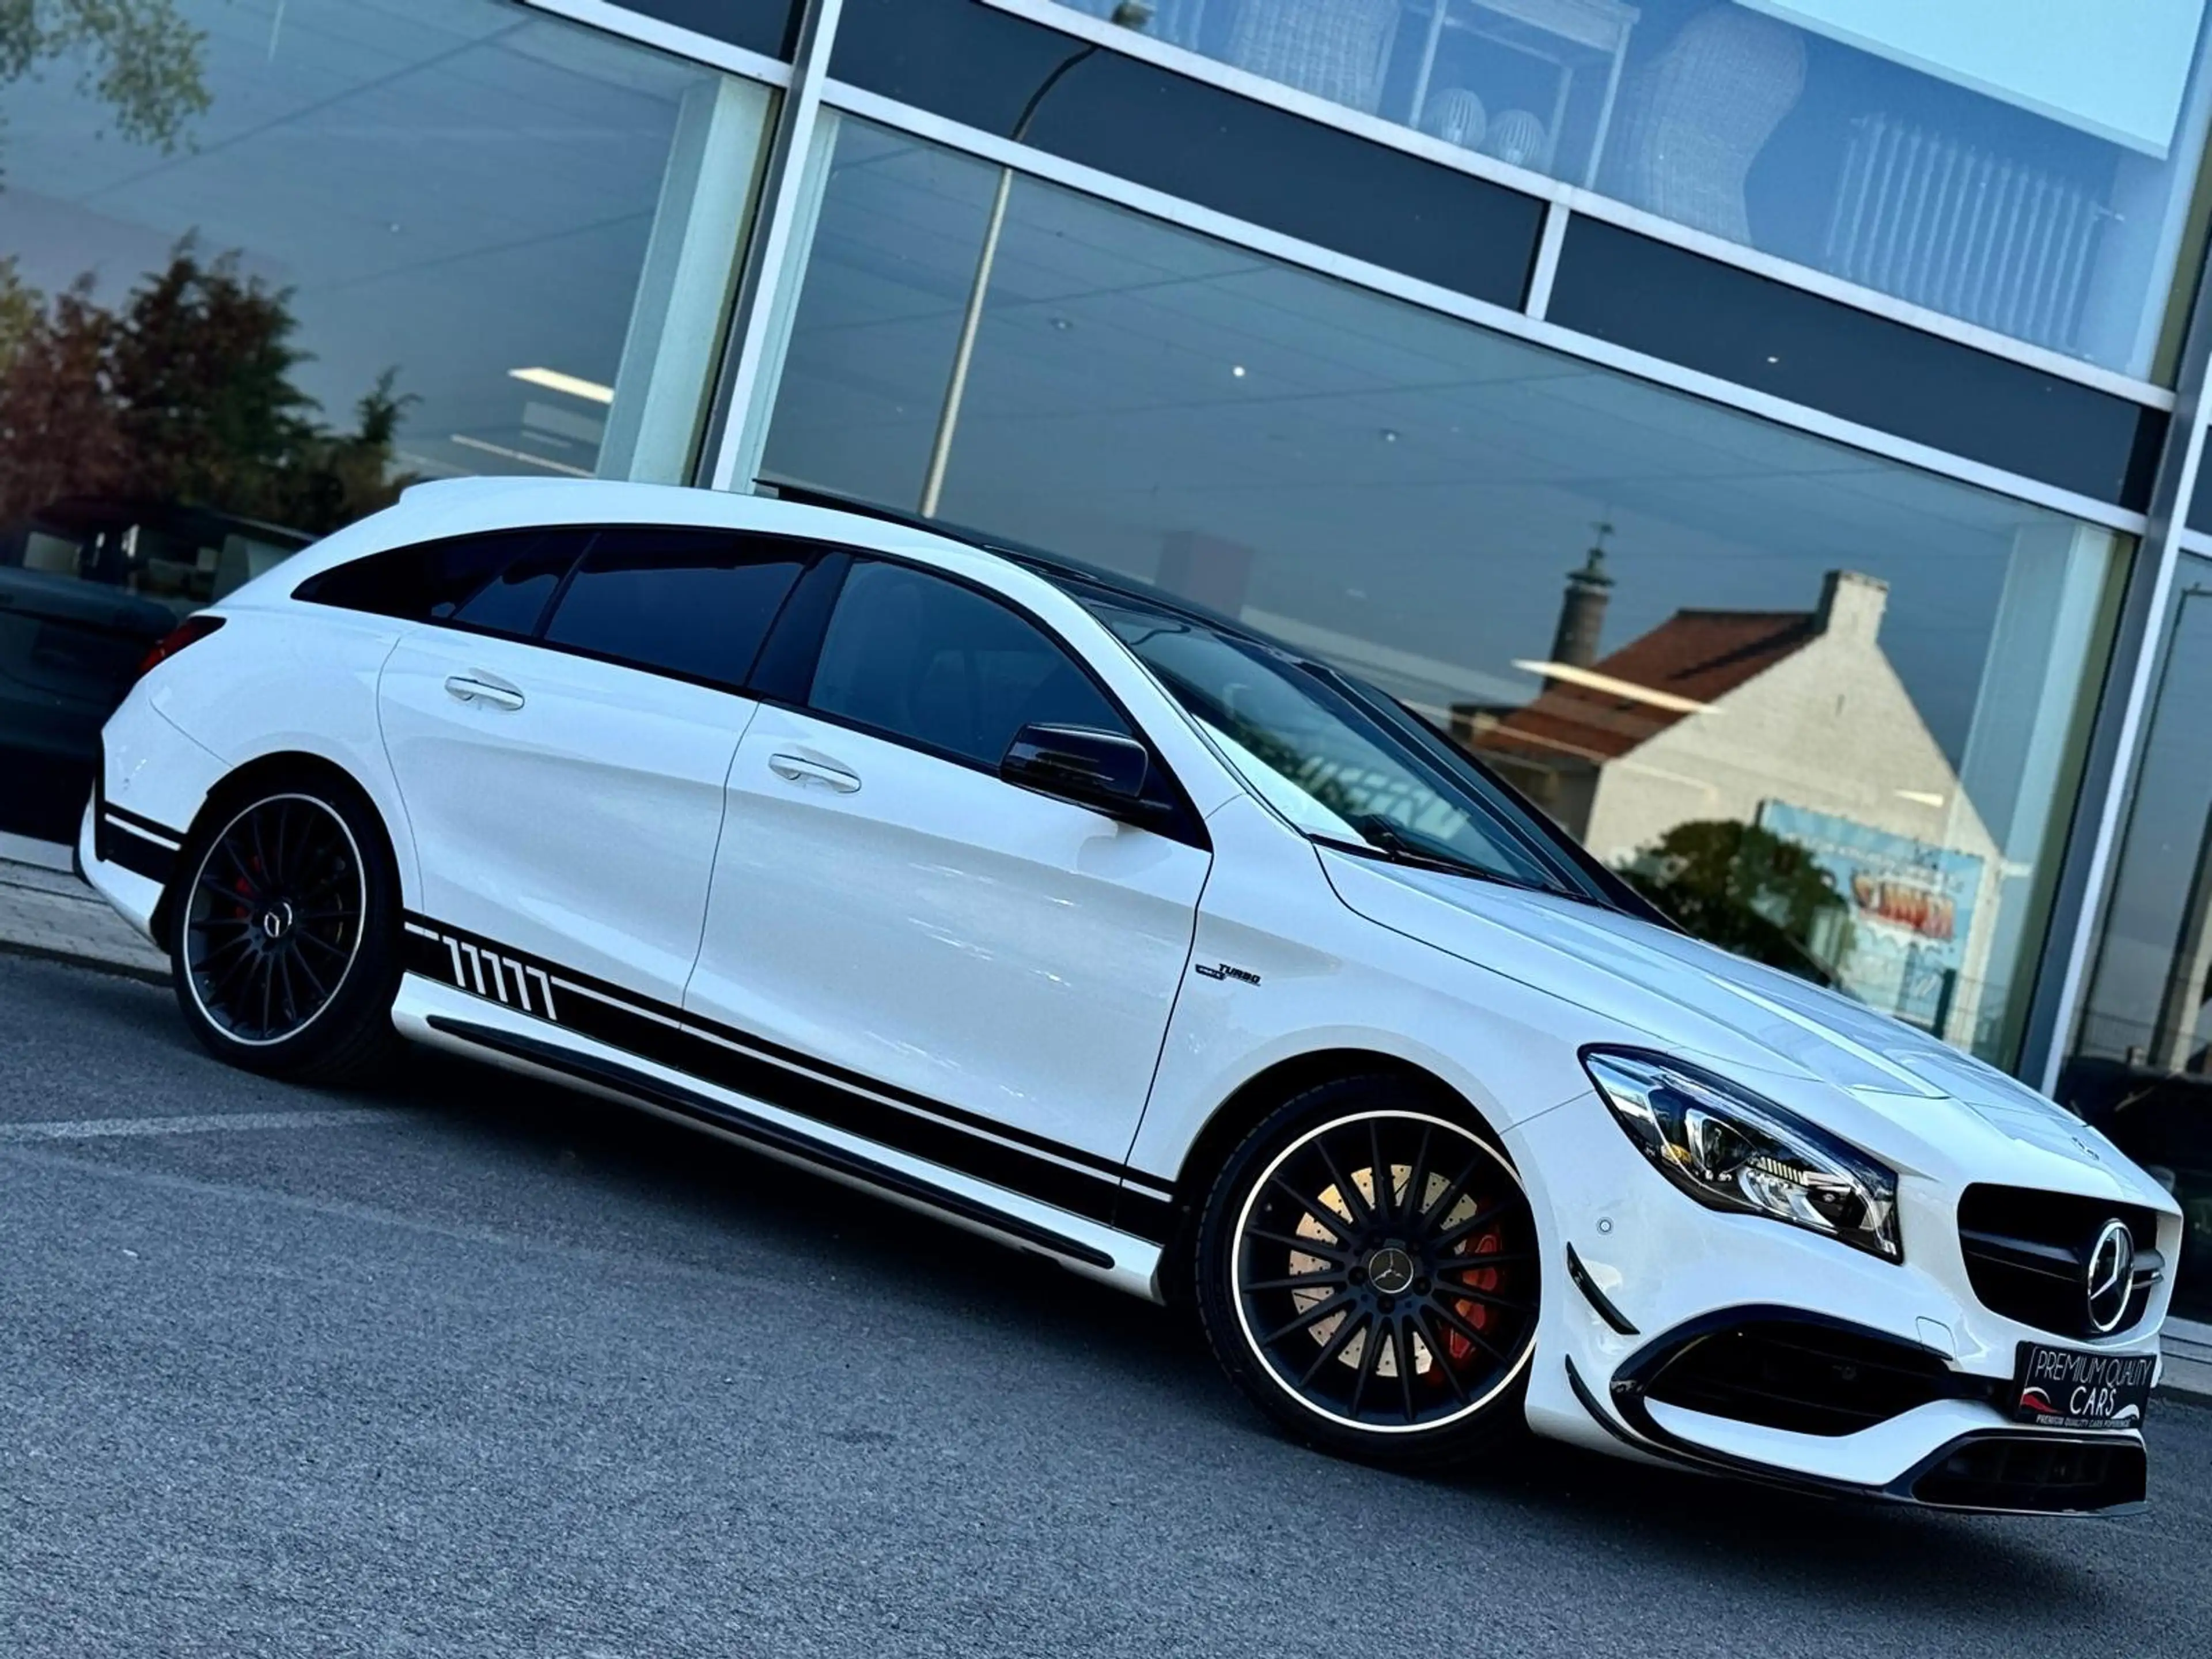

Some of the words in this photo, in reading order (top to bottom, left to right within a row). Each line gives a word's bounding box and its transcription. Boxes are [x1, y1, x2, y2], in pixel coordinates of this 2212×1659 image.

[1219, 963, 1261, 985] TURBO
[2035, 1350, 2107, 1384] PREMIUM
[2105, 1359, 2152, 1389] QUALITY
[2070, 1386, 2116, 1416] CARS
